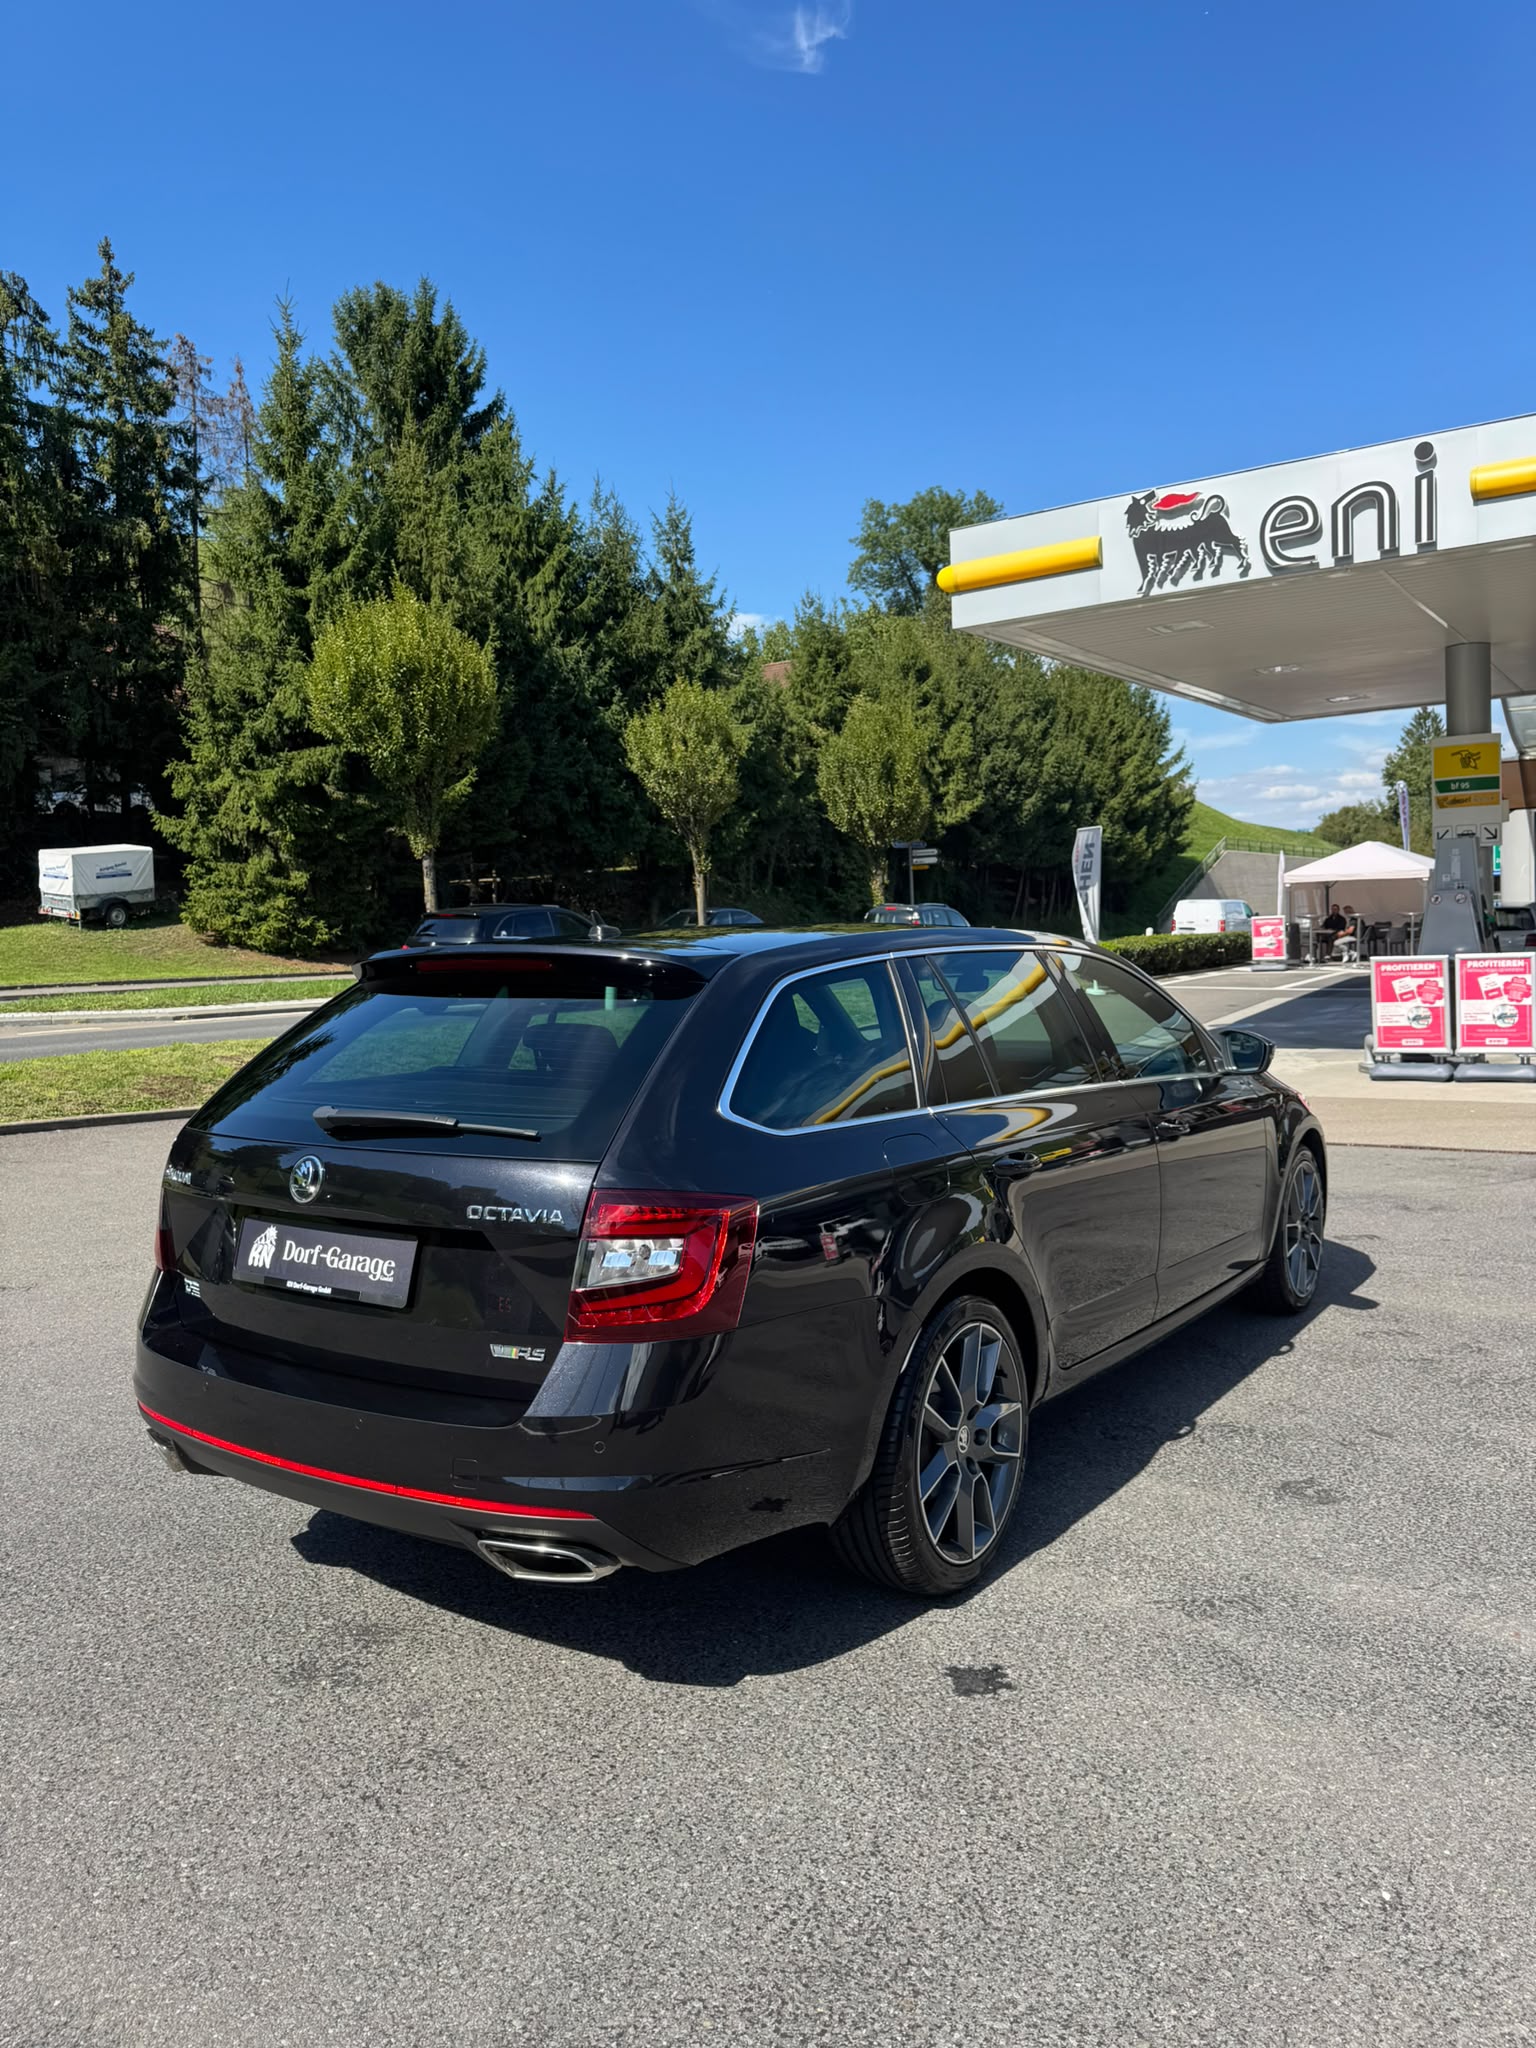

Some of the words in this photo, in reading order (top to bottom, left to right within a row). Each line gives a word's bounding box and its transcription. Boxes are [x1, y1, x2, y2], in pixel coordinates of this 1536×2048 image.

[1259, 441, 1436, 568] eni
[1460, 781, 1471, 790] 95
[1380, 962, 1436, 972] PROFITIEREN
[1466, 959, 1525, 969] PROFITIEREN
[466, 1205, 564, 1225] OCTAVIA
[282, 1240, 396, 1281] Dorf-Garage
